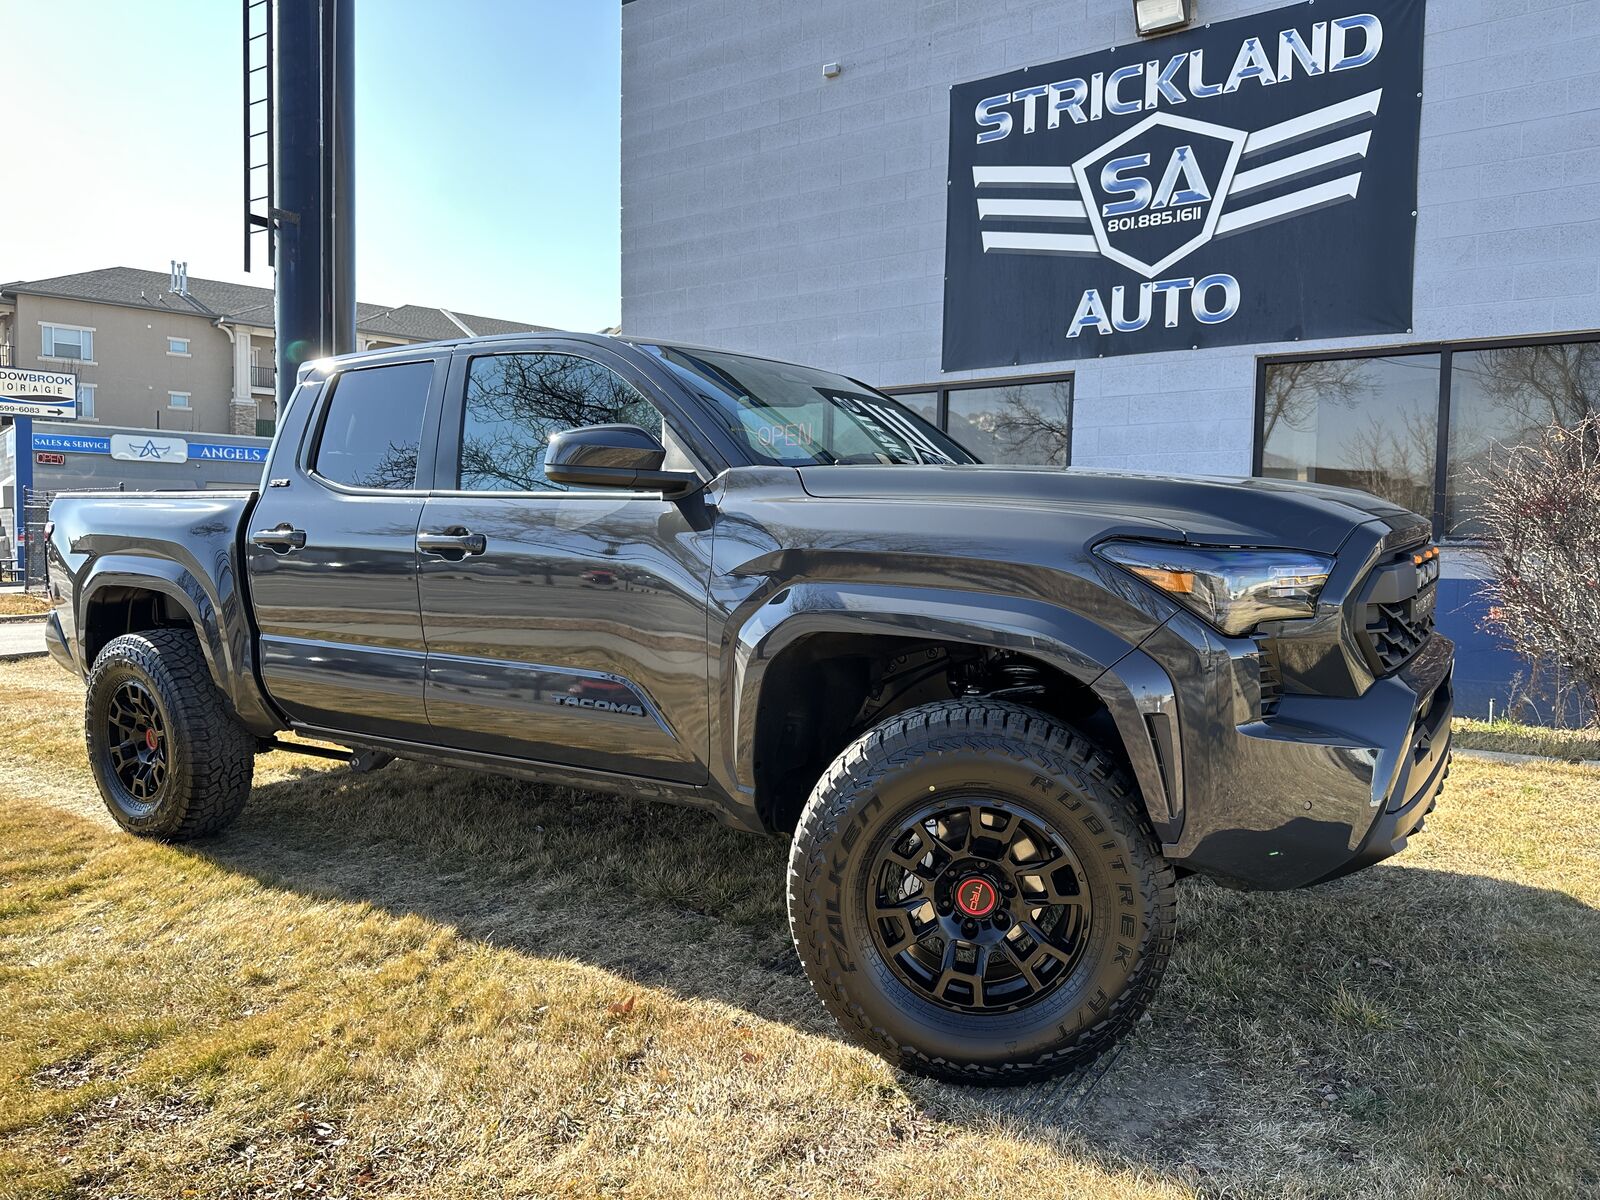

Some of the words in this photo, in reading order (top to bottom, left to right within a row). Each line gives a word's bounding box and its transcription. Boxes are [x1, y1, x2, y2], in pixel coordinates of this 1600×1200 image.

[975, 13, 1384, 145] STRICKLAND
[1100, 145, 1212, 218] SA
[1107, 206, 1202, 233] 801.885.1611
[1065, 273, 1241, 339] AUTO
[34, 438, 61, 447] SALES
[72, 441, 109, 450] SERVICE
[757, 422, 813, 447] OPEN
[200, 447, 260, 460] ANGELS
[551, 693, 645, 717] TACOMA
[1029, 775, 1139, 972] RUBITREK
[970, 884, 983, 911] TRD
